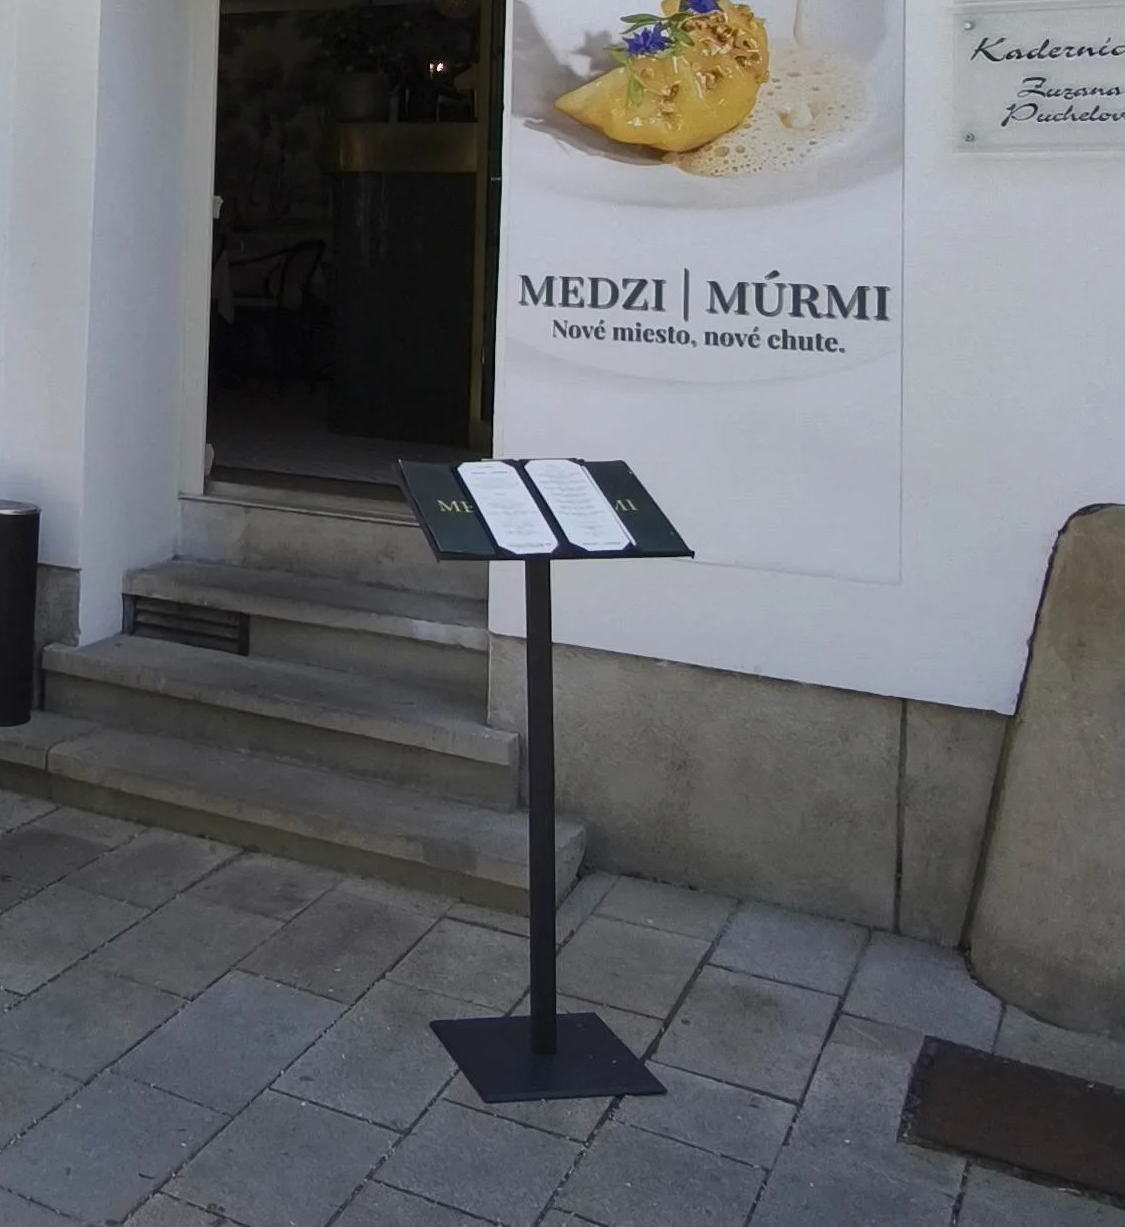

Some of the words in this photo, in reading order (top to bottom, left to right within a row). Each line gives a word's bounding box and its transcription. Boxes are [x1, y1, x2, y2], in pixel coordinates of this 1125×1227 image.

[1018, 76, 1121, 100] Zuzana
[518, 274, 666, 313] MEDZI
[705, 270, 891, 322] MÚRMI
[552, 320, 606, 341] Nové
[613, 323, 697, 348] miesto,
[704, 331, 761, 349] nové
[767, 329, 846, 354] chute.
